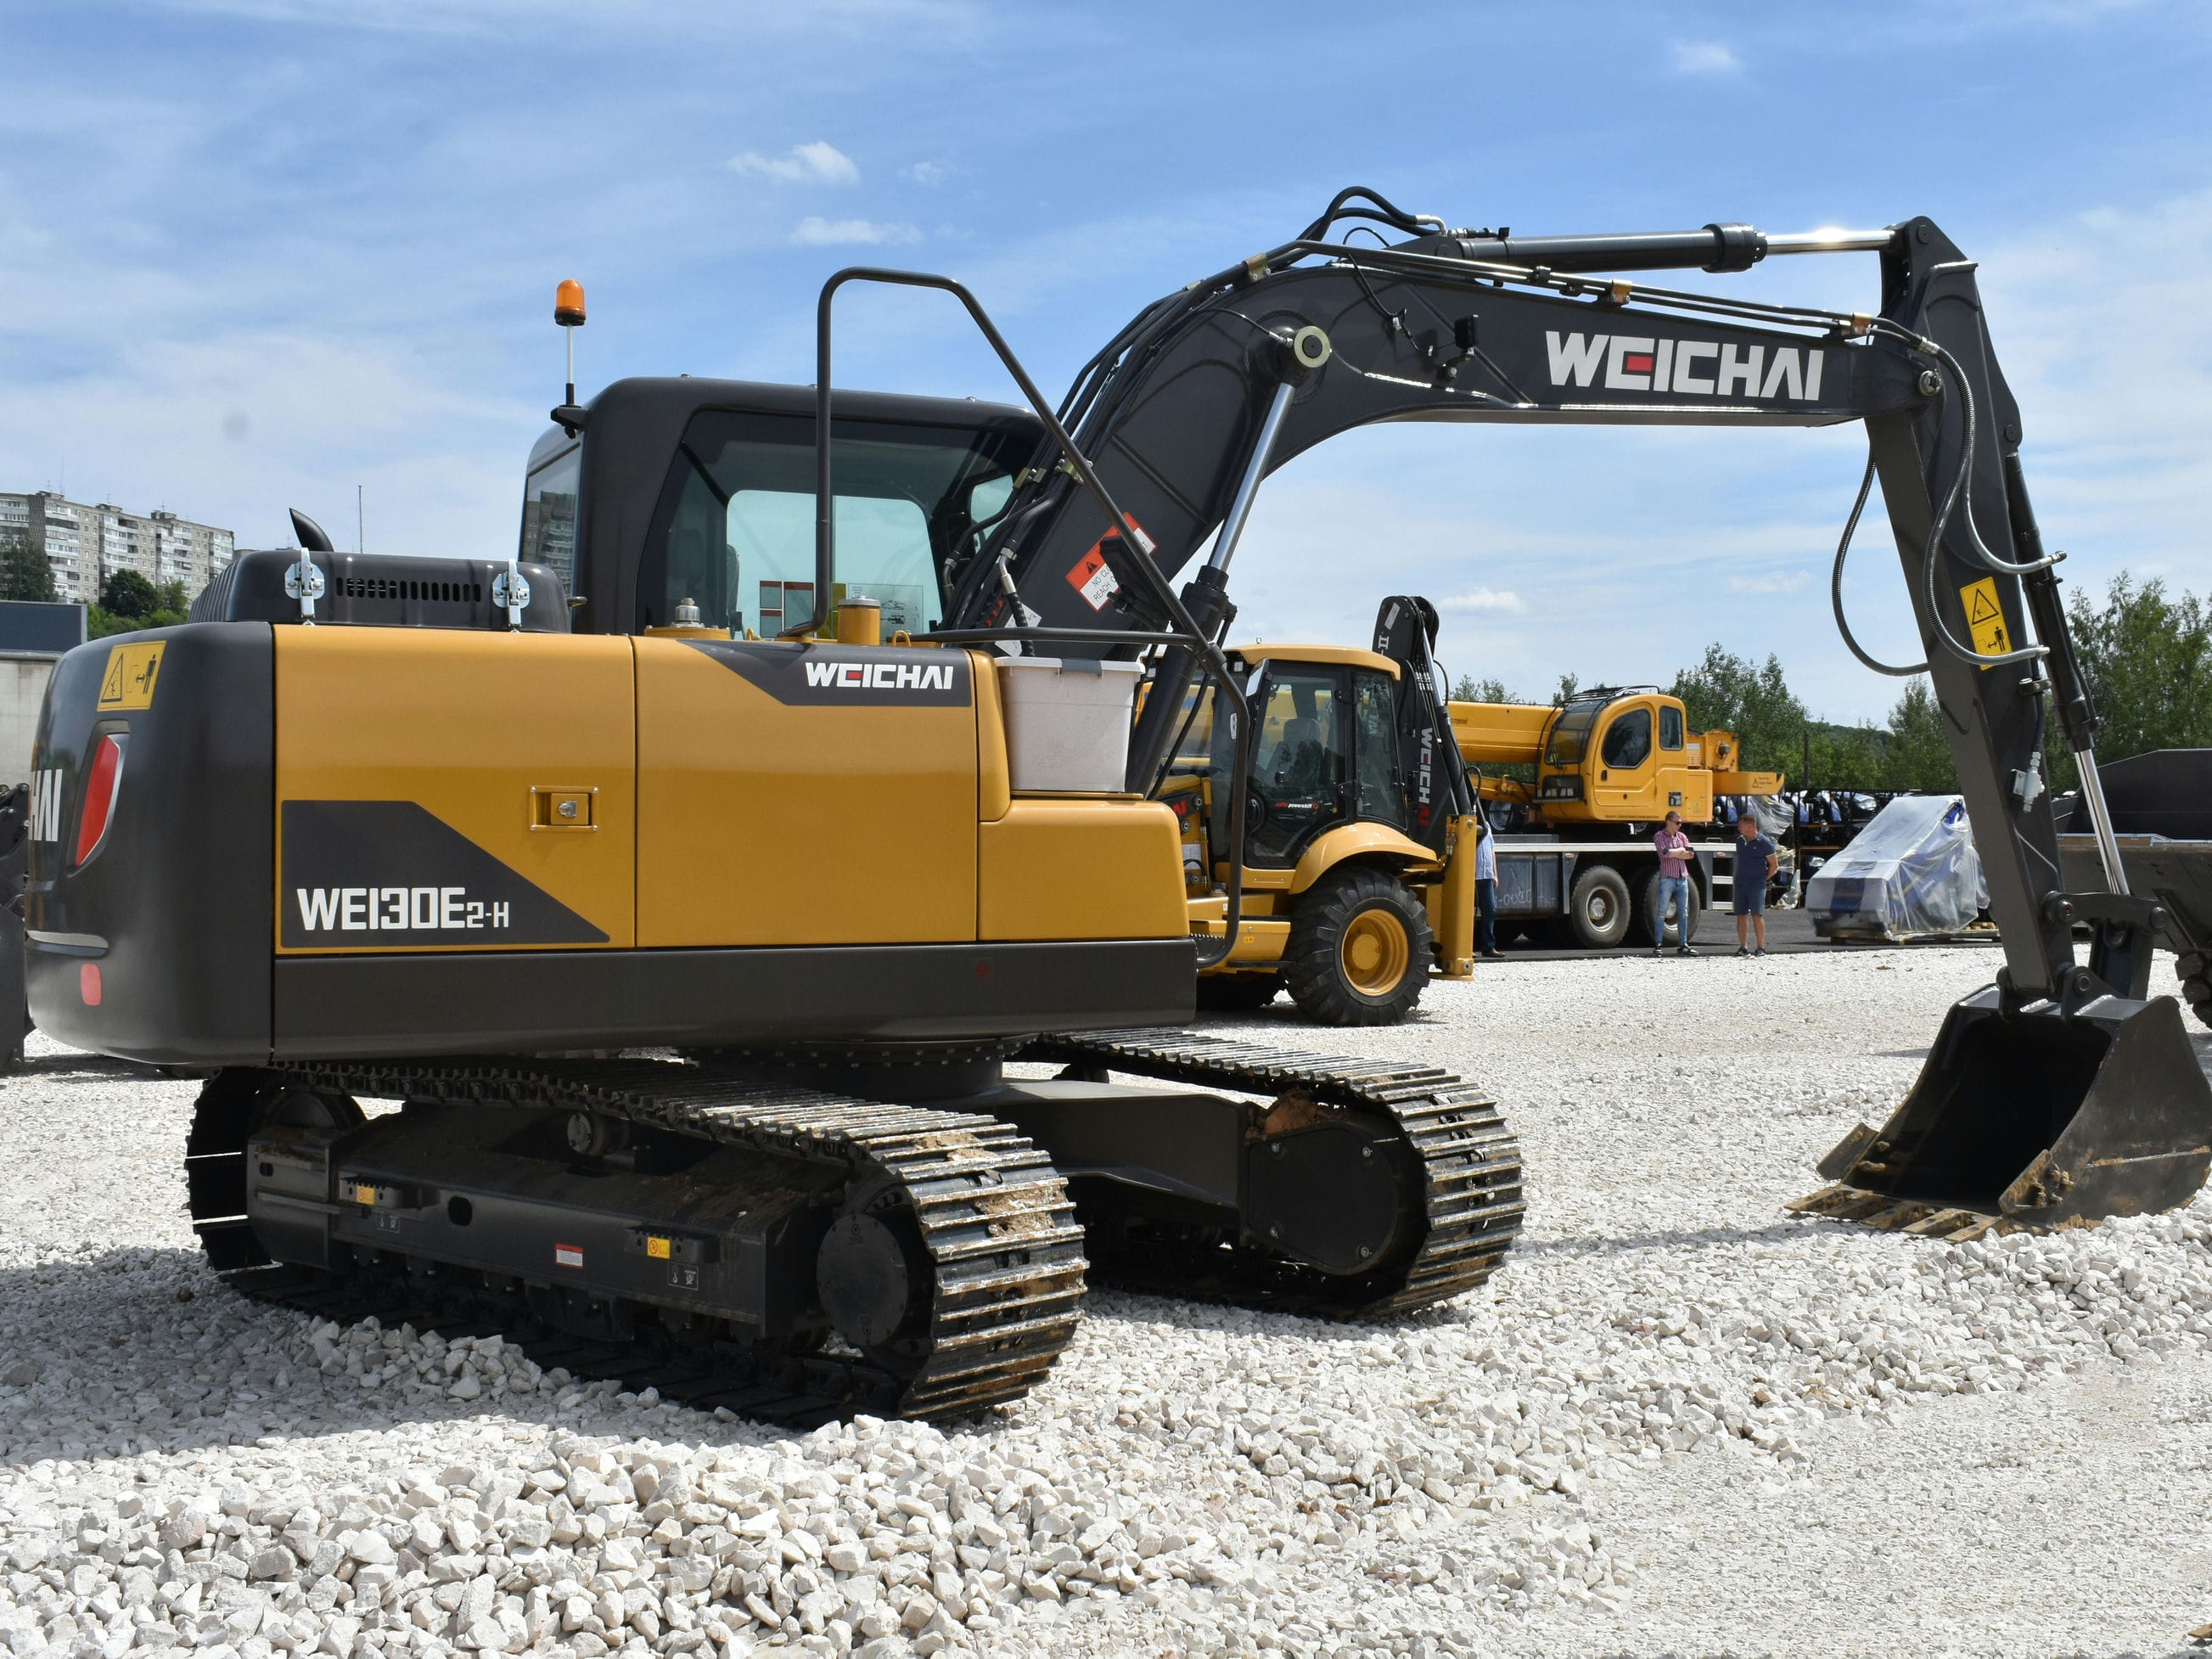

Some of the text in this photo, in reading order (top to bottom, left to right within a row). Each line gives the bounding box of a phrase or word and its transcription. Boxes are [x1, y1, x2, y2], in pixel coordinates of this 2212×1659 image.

[1546, 330, 1824, 401] WEICHAI
[1092, 576, 1102, 587] NO
[1092, 582, 1111, 601] REACH
[806, 662, 954, 689] WEICHAI
[1418, 727, 1433, 826] WEICHAI
